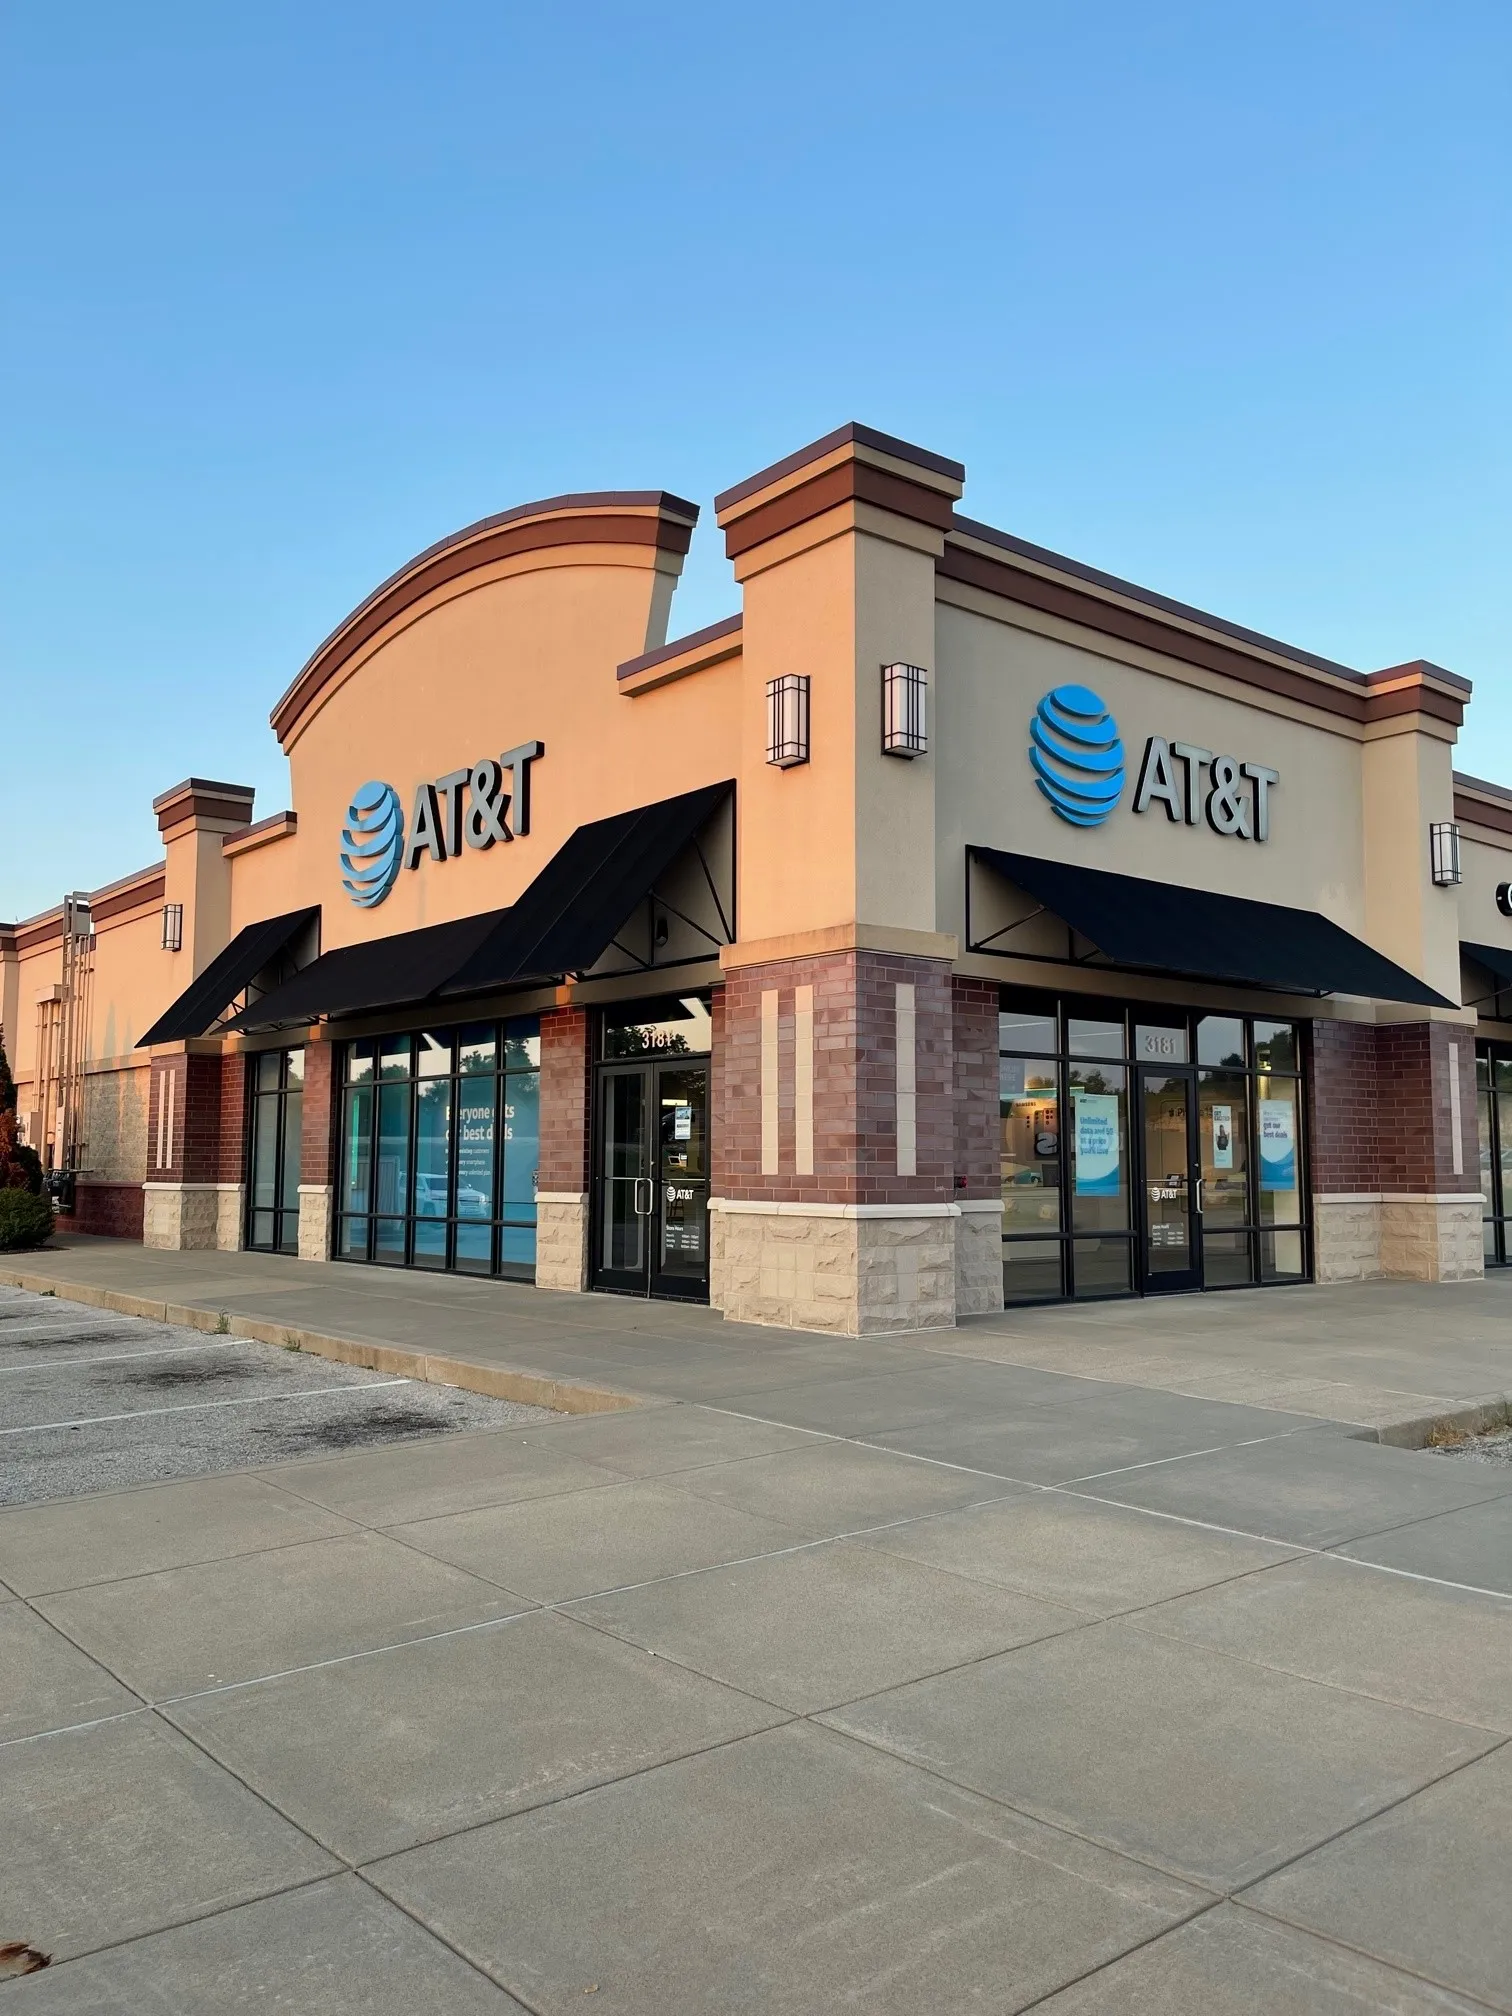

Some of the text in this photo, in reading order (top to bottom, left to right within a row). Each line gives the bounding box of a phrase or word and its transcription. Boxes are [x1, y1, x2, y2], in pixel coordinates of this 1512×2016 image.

[1132, 736, 1279, 842] AT&T
[404, 740, 545, 870] AT&T
[1145, 1036, 1176, 1054] 3181
[463, 1125, 485, 1141] best
[486, 1123, 513, 1140] dls
[676, 1189, 694, 1200] AT&T
[1160, 1189, 1177, 1199] AT&T
